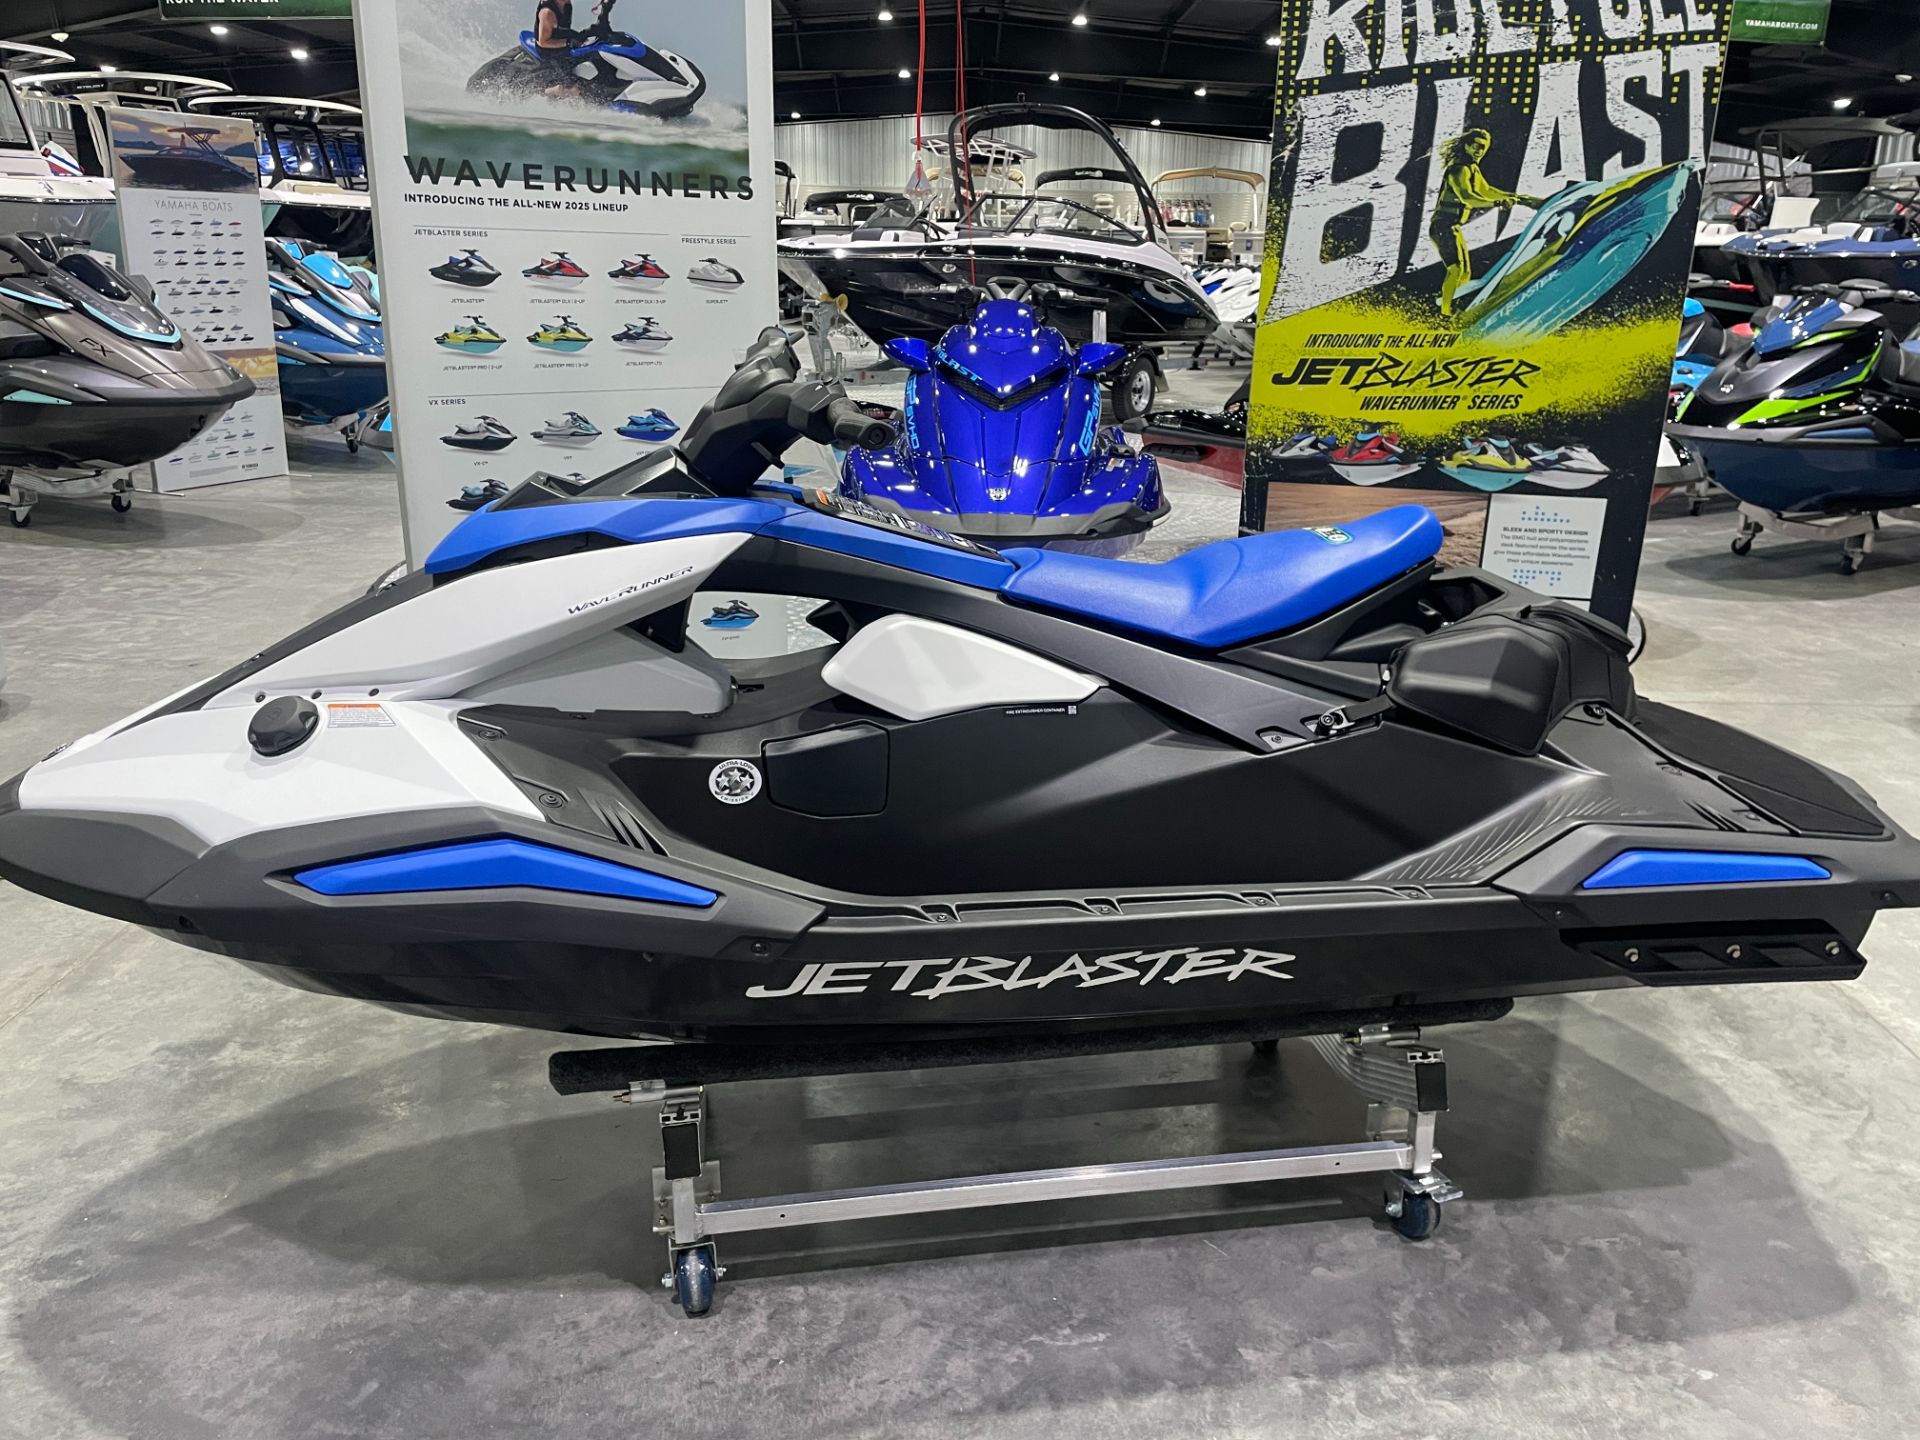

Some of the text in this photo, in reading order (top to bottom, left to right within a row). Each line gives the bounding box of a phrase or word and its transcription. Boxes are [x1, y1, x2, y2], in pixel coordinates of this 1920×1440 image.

[1745, 19, 1818, 30] YAMAHABOATS.COM
[403, 155, 754, 200] WAVERUNNERS
[1258, 42, 1720, 327] BLAST
[154, 200, 233, 212] YAMAHA BOATS
[404, 193, 629, 212] INTRODUCING THE ALL-NEW 2025 LINEUP
[414, 228, 489, 238] JETBLASTER SERIES
[682, 237, 715, 245] FREESTYLE
[79, 337, 115, 358] FX
[1304, 333, 1460, 348] INTRODUCING THE ALL-NEW
[1271, 352, 1541, 393] JETBLASTER
[441, 398, 466, 406] SERIES
[1467, 394, 1523, 410] SERIES
[906, 405, 920, 450] SVHO
[1079, 410, 1094, 456] GP
[568, 566, 694, 614] WAVERUNNER
[745, 947, 1296, 1000] JETBLASTER
